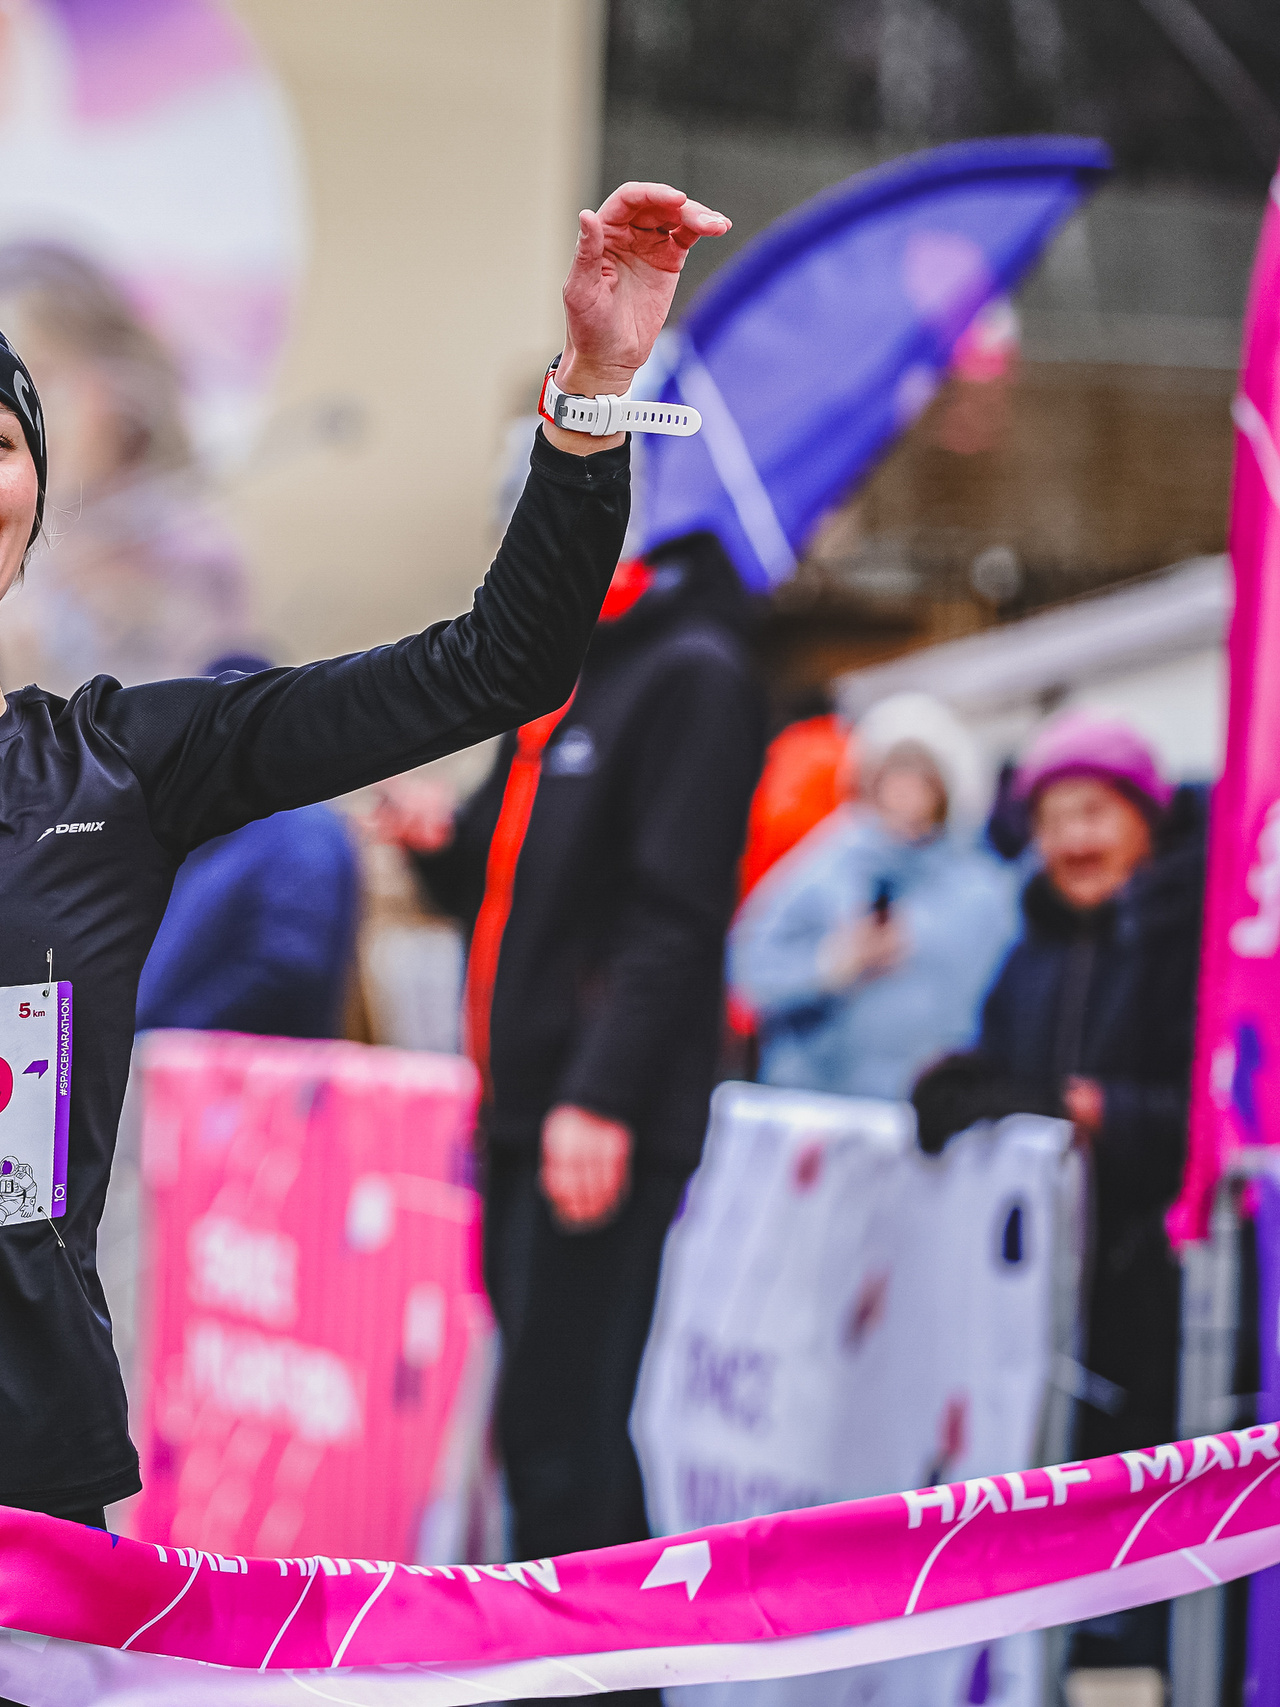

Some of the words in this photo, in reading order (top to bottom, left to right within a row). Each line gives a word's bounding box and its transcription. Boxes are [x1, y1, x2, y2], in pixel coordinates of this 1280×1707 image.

[55, 821, 106, 834] DEMIX
[18, 1002, 31, 1018] 5
[33, 1010, 46, 1018] km
[59, 997, 70, 1096] #SPACEMARATHON
[901, 1461, 1092, 1529] HALF
